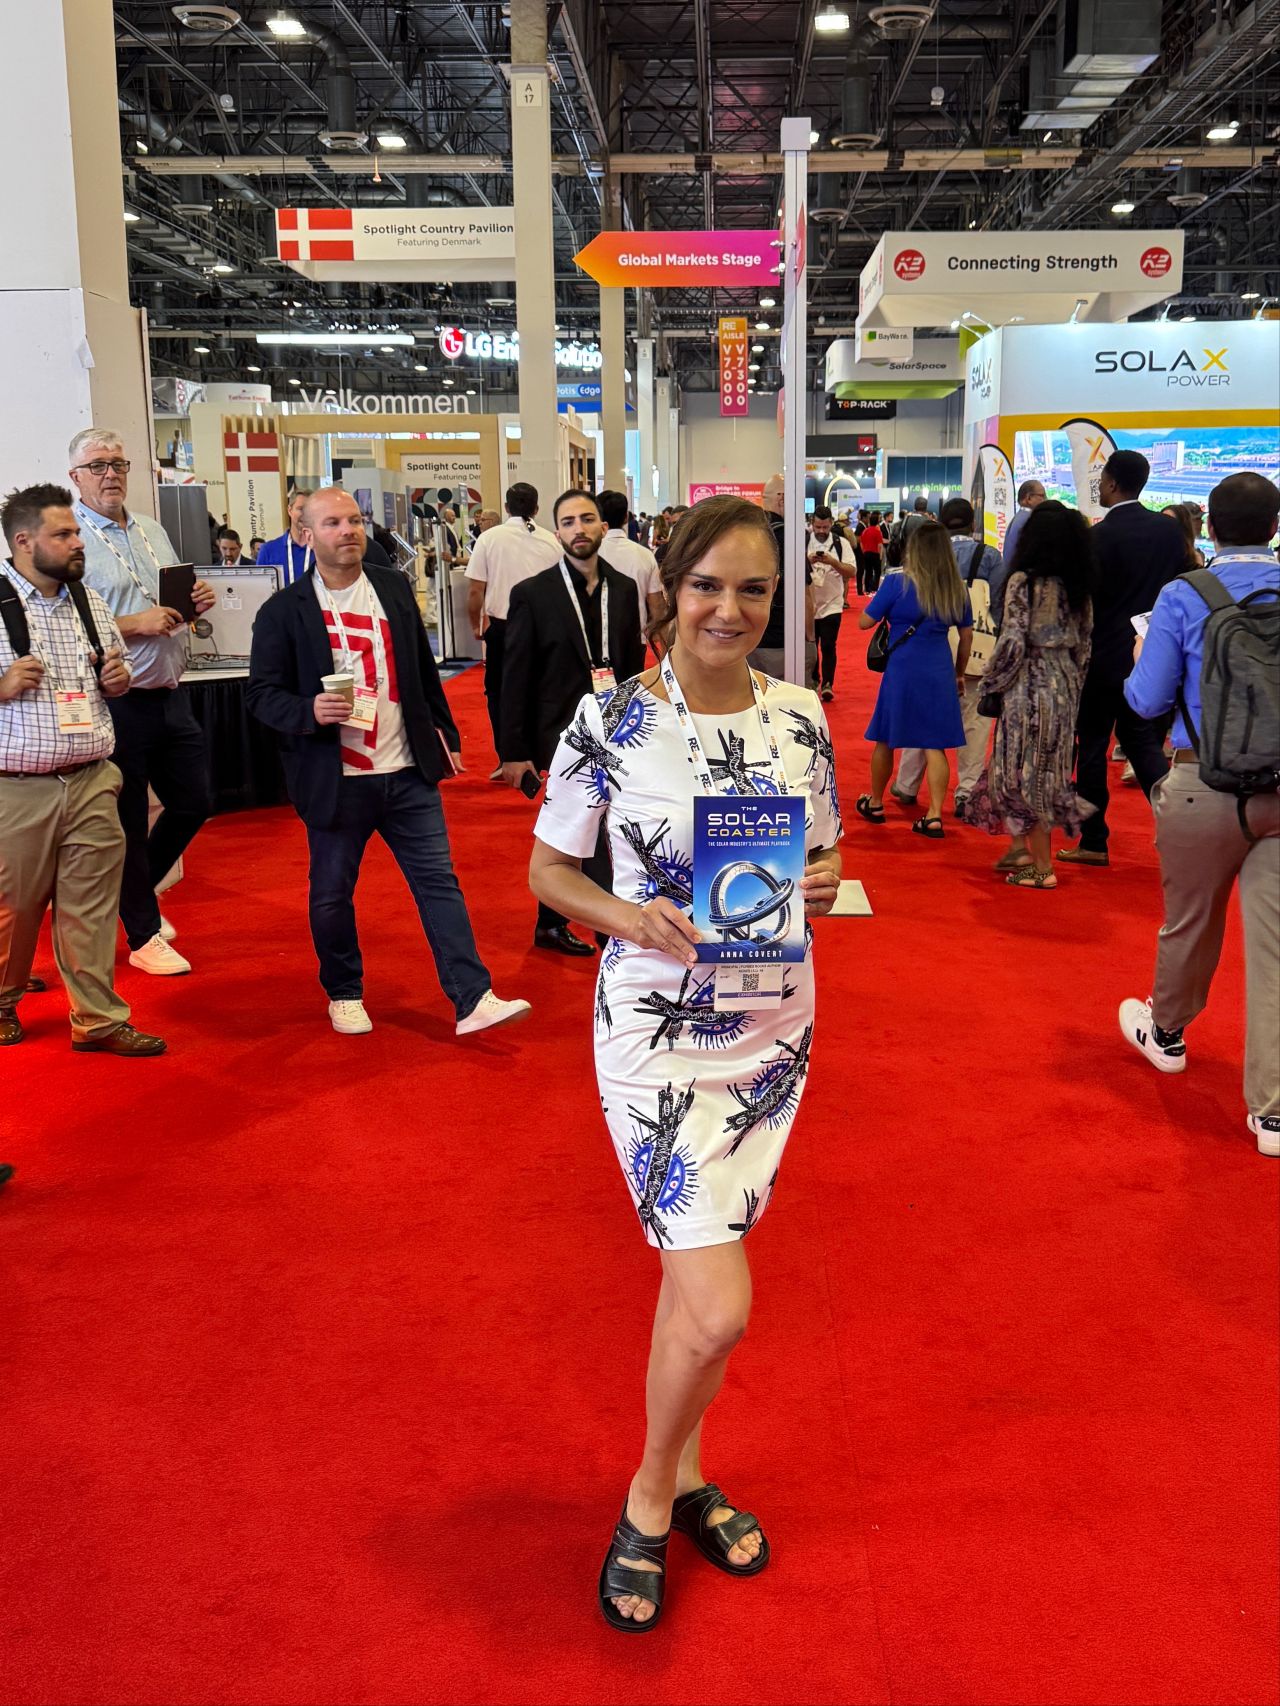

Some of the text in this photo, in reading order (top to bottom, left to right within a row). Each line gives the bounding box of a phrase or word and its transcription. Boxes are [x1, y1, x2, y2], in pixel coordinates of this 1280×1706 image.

[525, 83, 532, 91] A
[525, 95, 534, 103] 17
[363, 223, 514, 235] Spotlight Country Pavilion
[397, 238, 482, 247] Featuring Denmark
[618, 253, 761, 267] Global Markets Stage
[948, 254, 1118, 272] Connecting Strength
[723, 332, 744, 340] AISLE
[465, 331, 492, 357] LG
[889, 362, 947, 371] SolarSpace
[1095, 348, 1229, 373] SOLAX
[1167, 374, 1230, 387] POWER
[580, 387, 601, 396] Edge
[407, 462, 449, 472] Spotlight
[248, 479, 256, 511] Pavilion
[675, 702, 687, 717] RE
[761, 710, 770, 723] RE
[688, 737, 700, 752] RE
[770, 745, 779, 758] RE
[700, 773, 712, 788] RE
[778, 781, 788, 795] RE
[708, 813, 791, 825] SOLAR
[708, 828, 791, 837] COASTER
